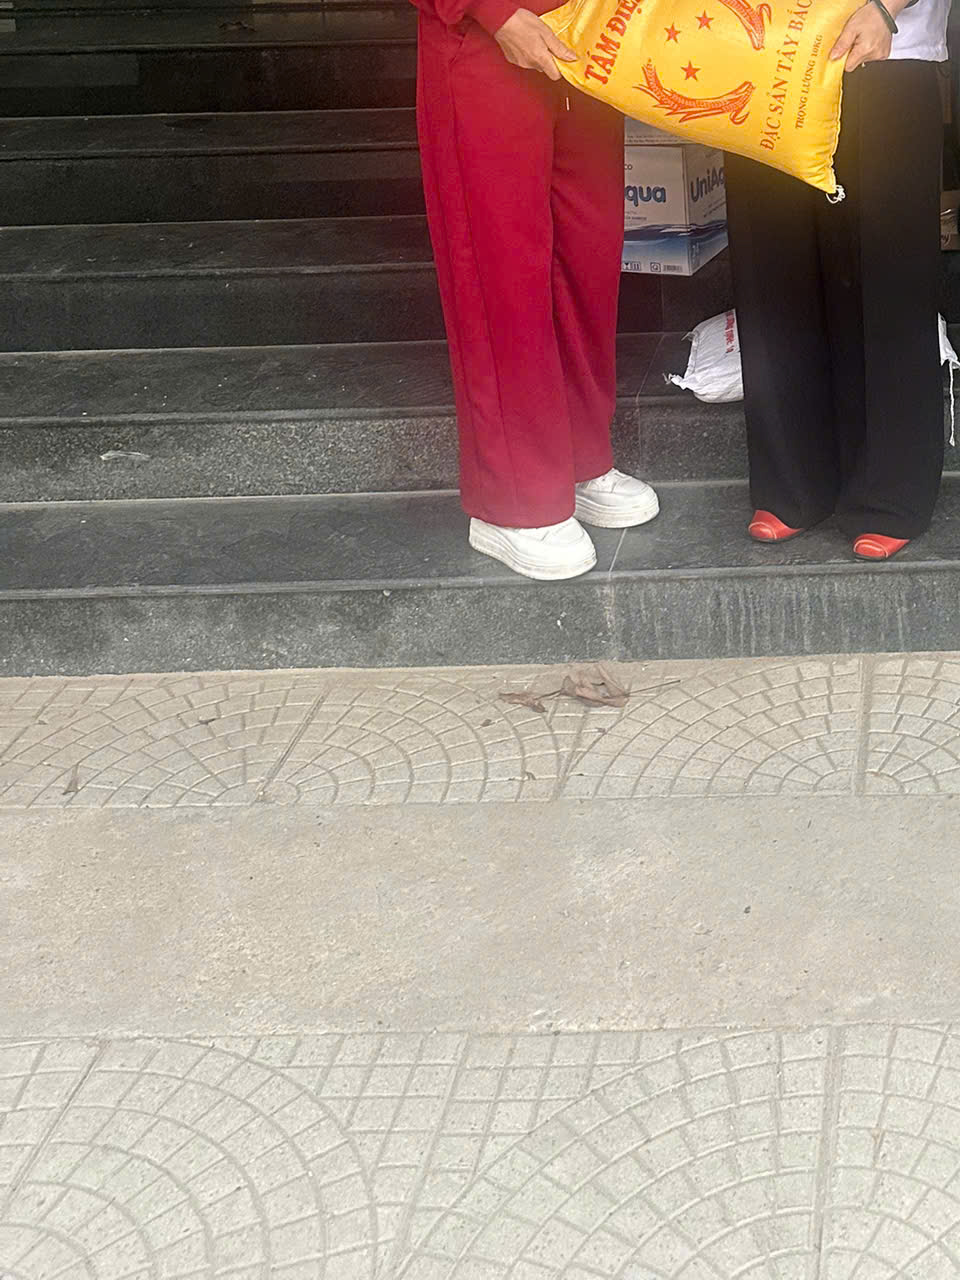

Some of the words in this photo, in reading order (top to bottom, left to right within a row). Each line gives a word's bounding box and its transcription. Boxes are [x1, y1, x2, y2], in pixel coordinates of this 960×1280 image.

[776, 34, 800, 72] TÂY
[766, 76, 789, 115] SẢN
[760, 116, 781, 151] ĐẶC
